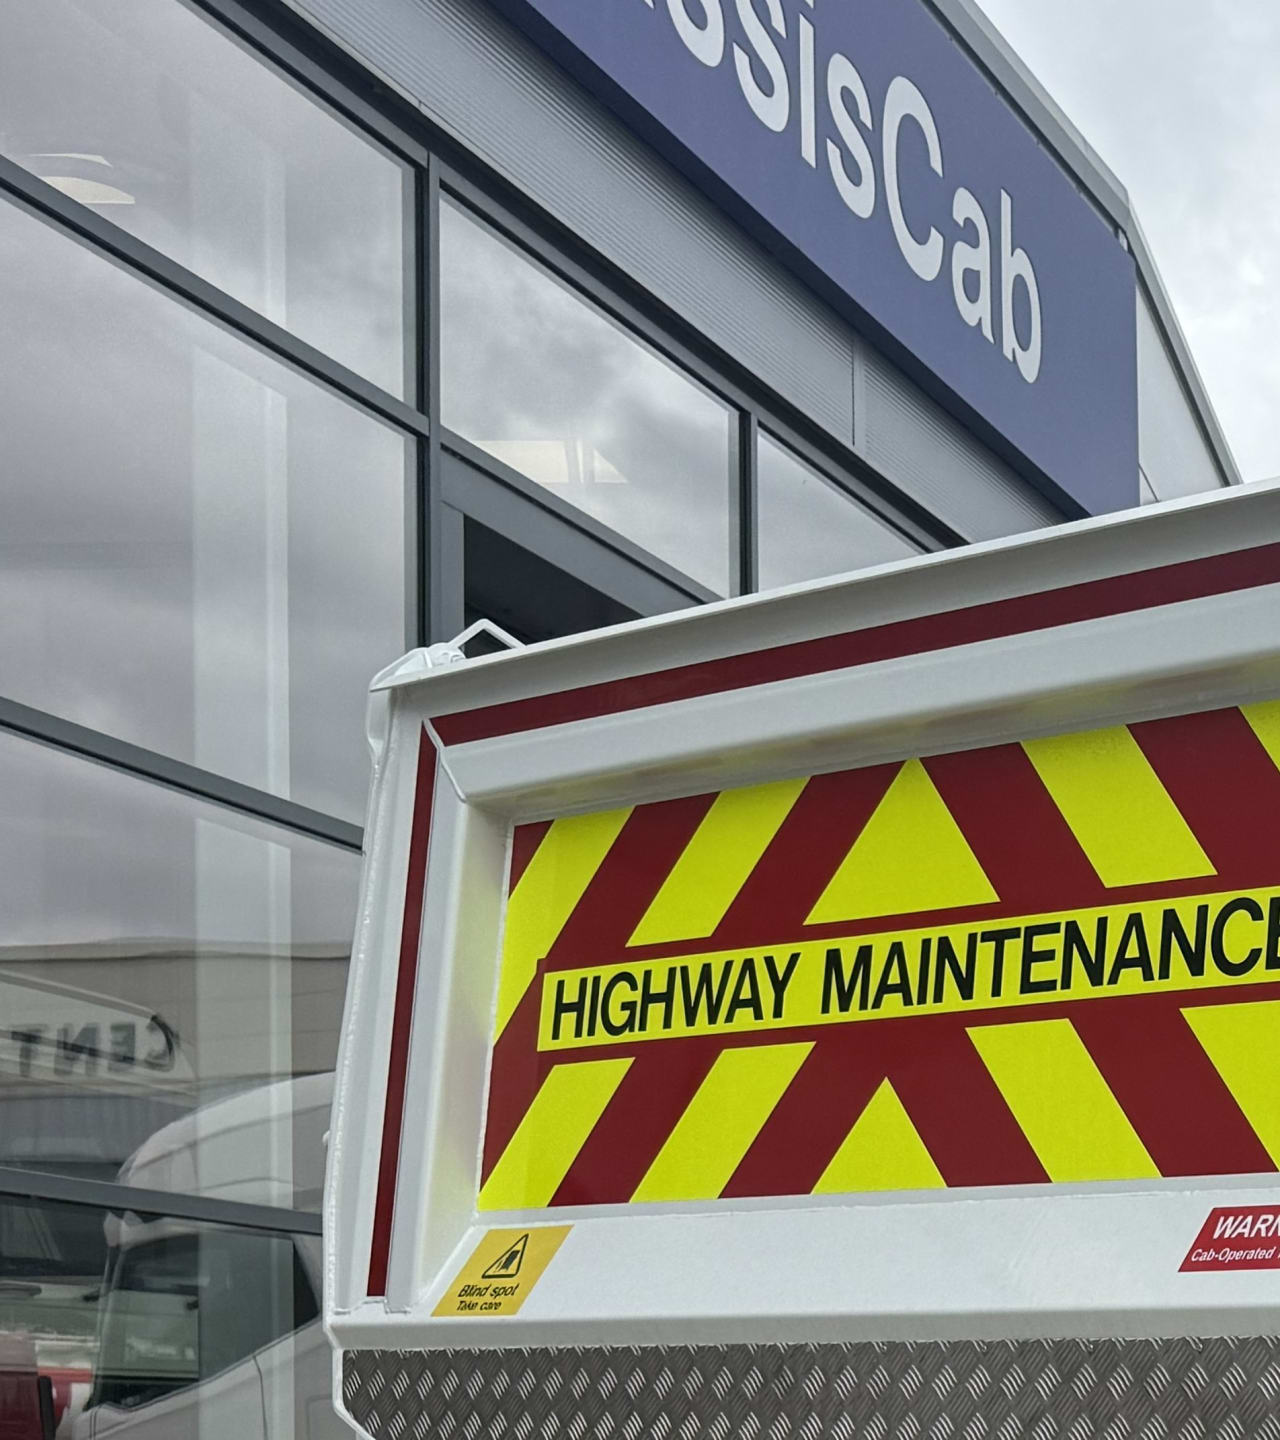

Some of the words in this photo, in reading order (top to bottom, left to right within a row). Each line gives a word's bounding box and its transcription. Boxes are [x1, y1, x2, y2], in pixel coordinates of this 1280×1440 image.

[644, 0, 1042, 384] sisCab
[551, 952, 800, 1041] HIGHWAY
[1191, 1246, 1277, 1264] Cab-Operated
[458, 1283, 492, 1298] Blind
[490, 1282, 520, 1299] spot
[456, 1300, 479, 1311] Take
[479, 1301, 502, 1311] care
